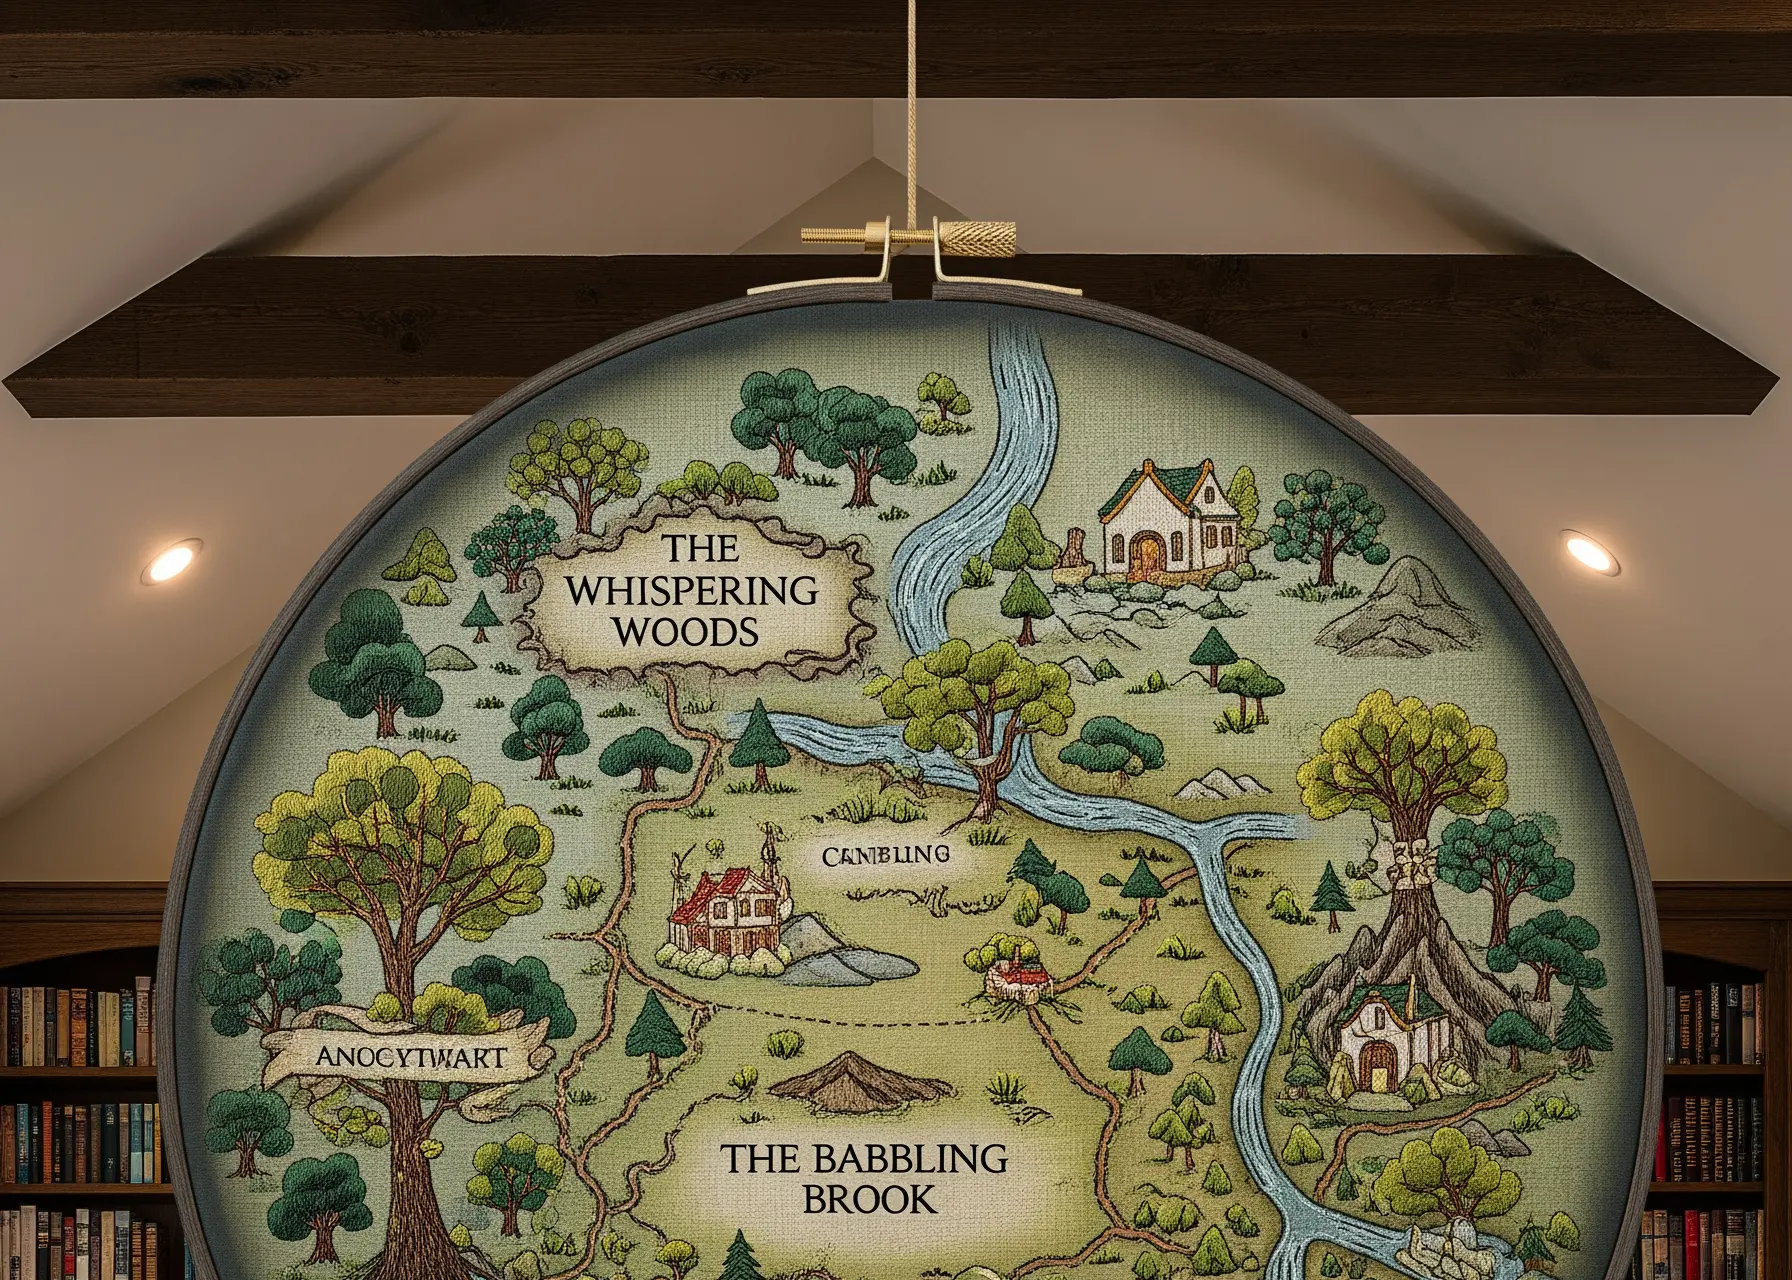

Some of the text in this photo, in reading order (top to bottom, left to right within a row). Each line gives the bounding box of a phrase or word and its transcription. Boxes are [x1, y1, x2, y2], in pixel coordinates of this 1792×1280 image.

[661, 534, 740, 563] THE
[563, 575, 818, 606] WHISPERING
[610, 616, 759, 647] WOODS
[720, 1144, 1009, 1174] THE BABBLING
[803, 1184, 938, 1214] BROOK
